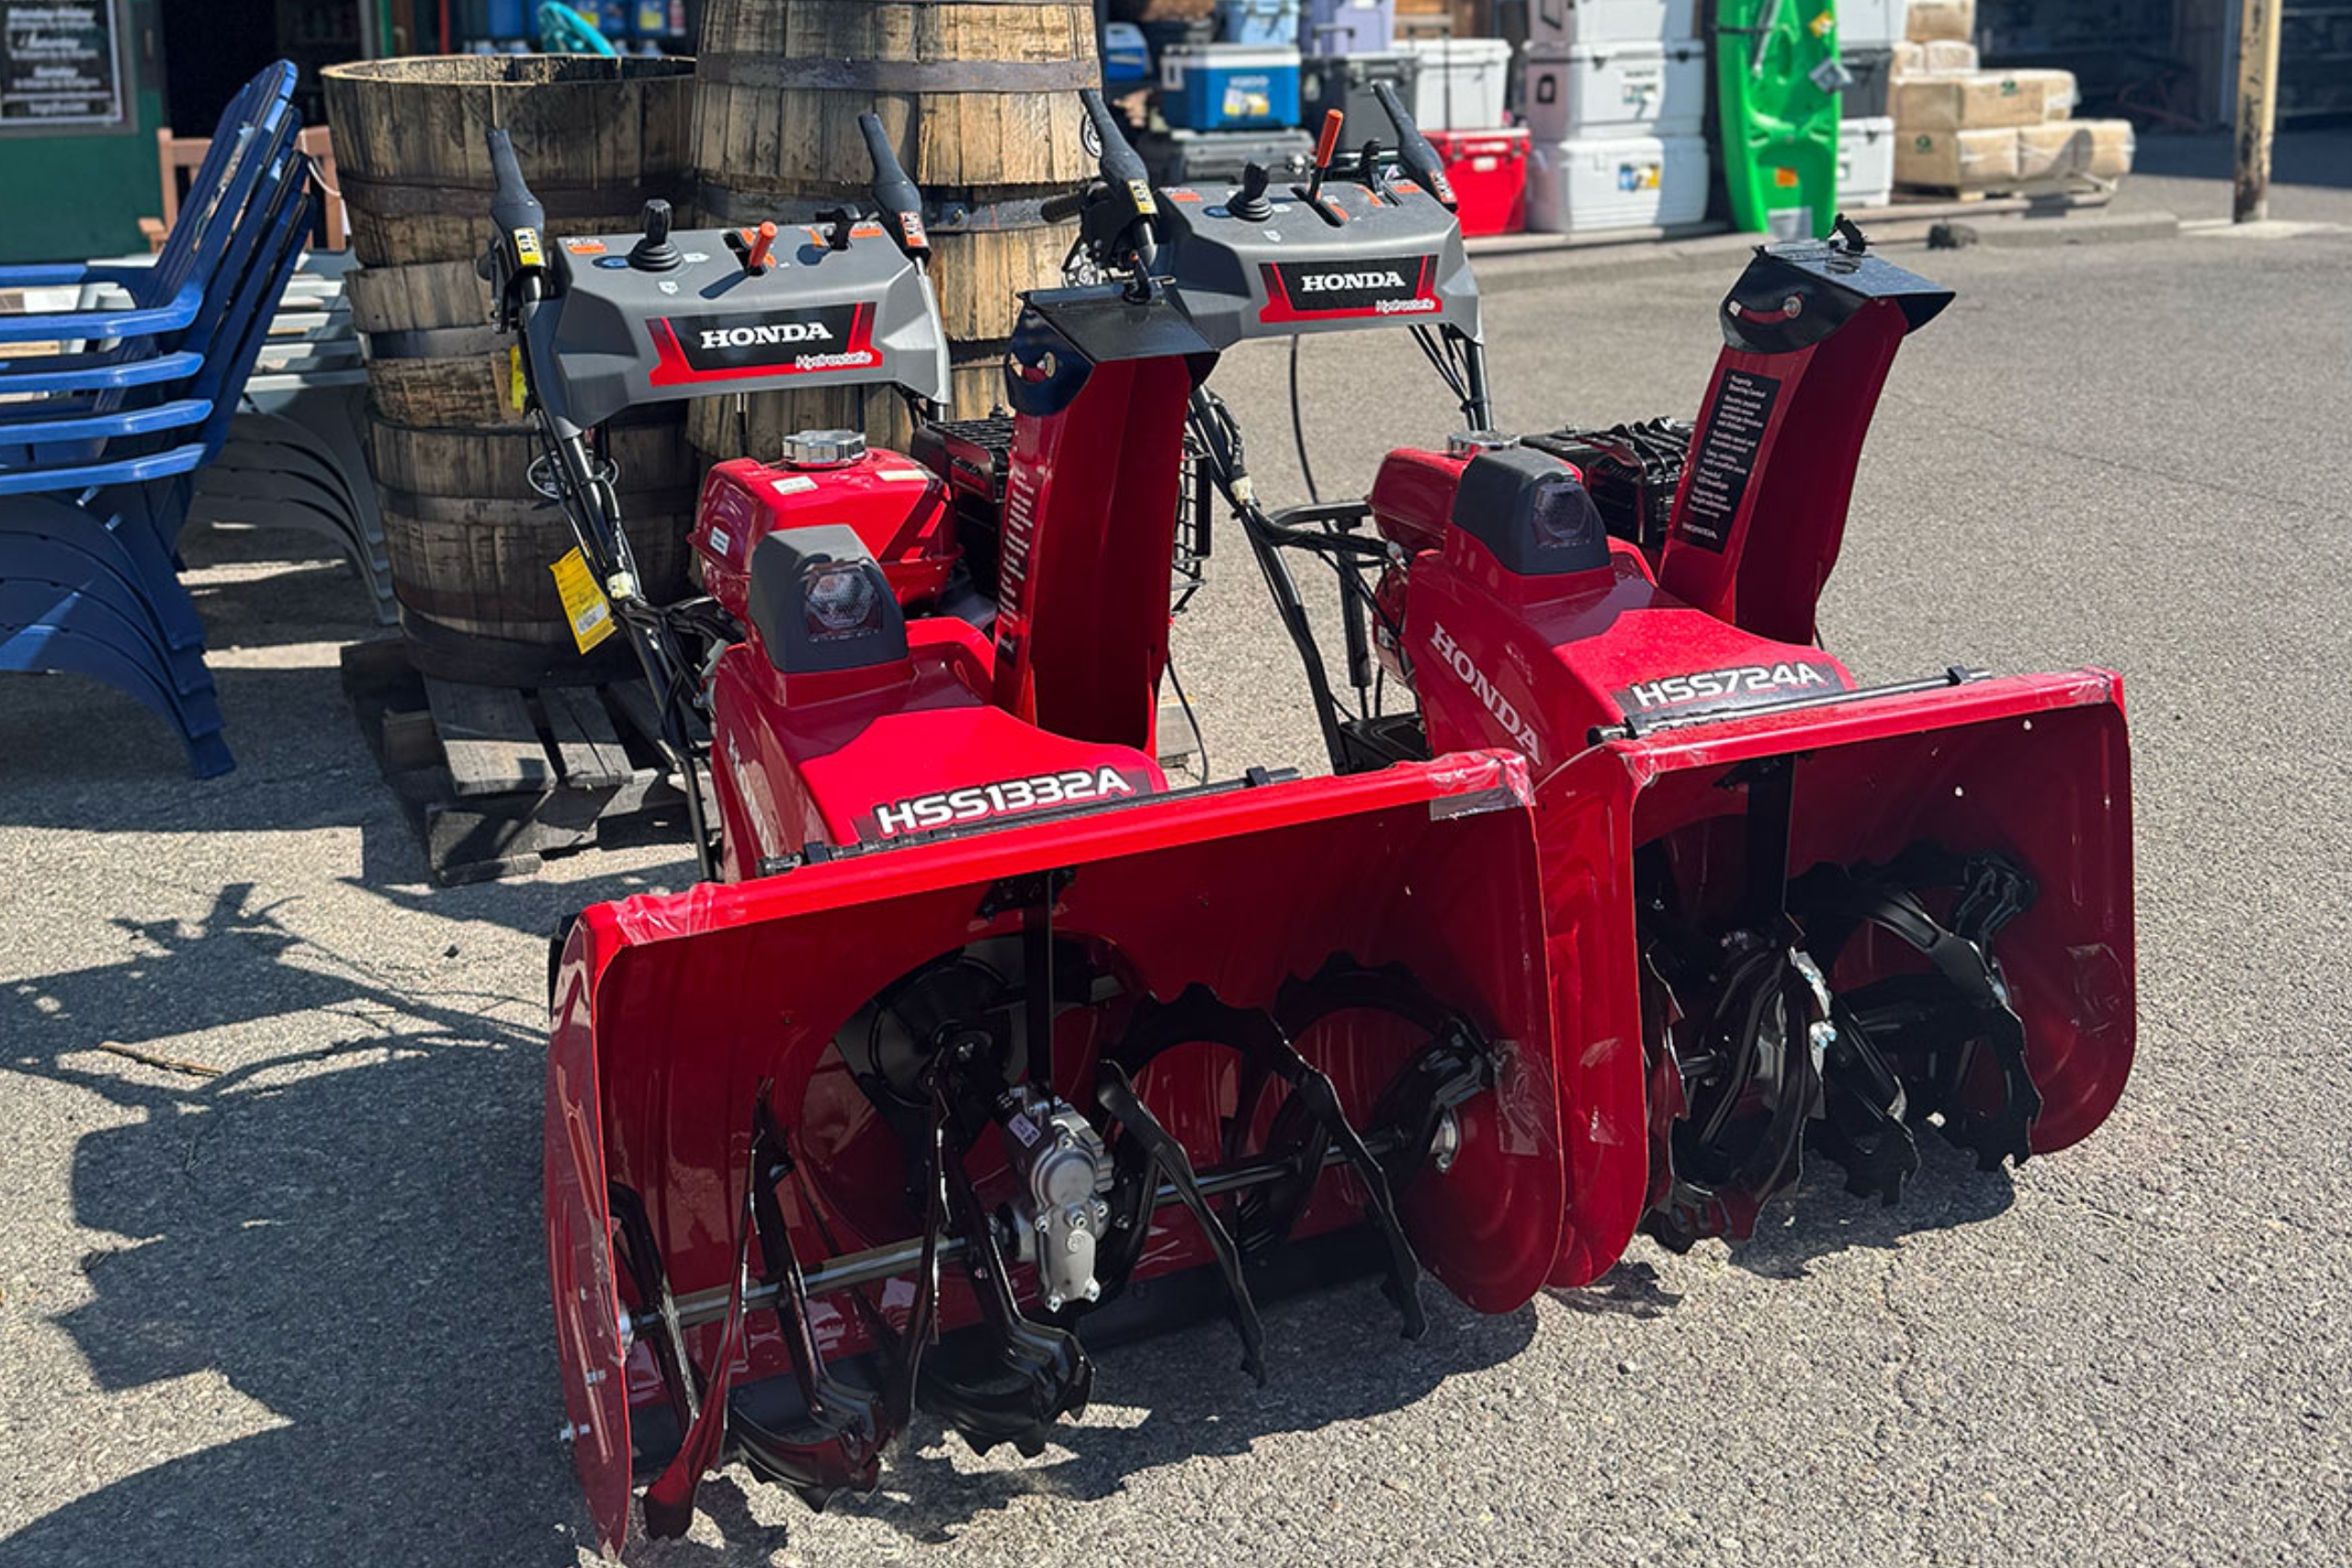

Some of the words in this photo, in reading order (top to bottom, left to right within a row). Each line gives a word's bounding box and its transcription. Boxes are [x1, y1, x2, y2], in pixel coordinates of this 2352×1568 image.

[1302, 271, 1407, 292] HONDA
[700, 321, 833, 349] HONDA
[1681, 521, 1718, 539] HONDA
[1430, 621, 1542, 766] HONDA
[1631, 662, 1826, 708] HSS724A
[875, 766, 1132, 834] HSS1332A
